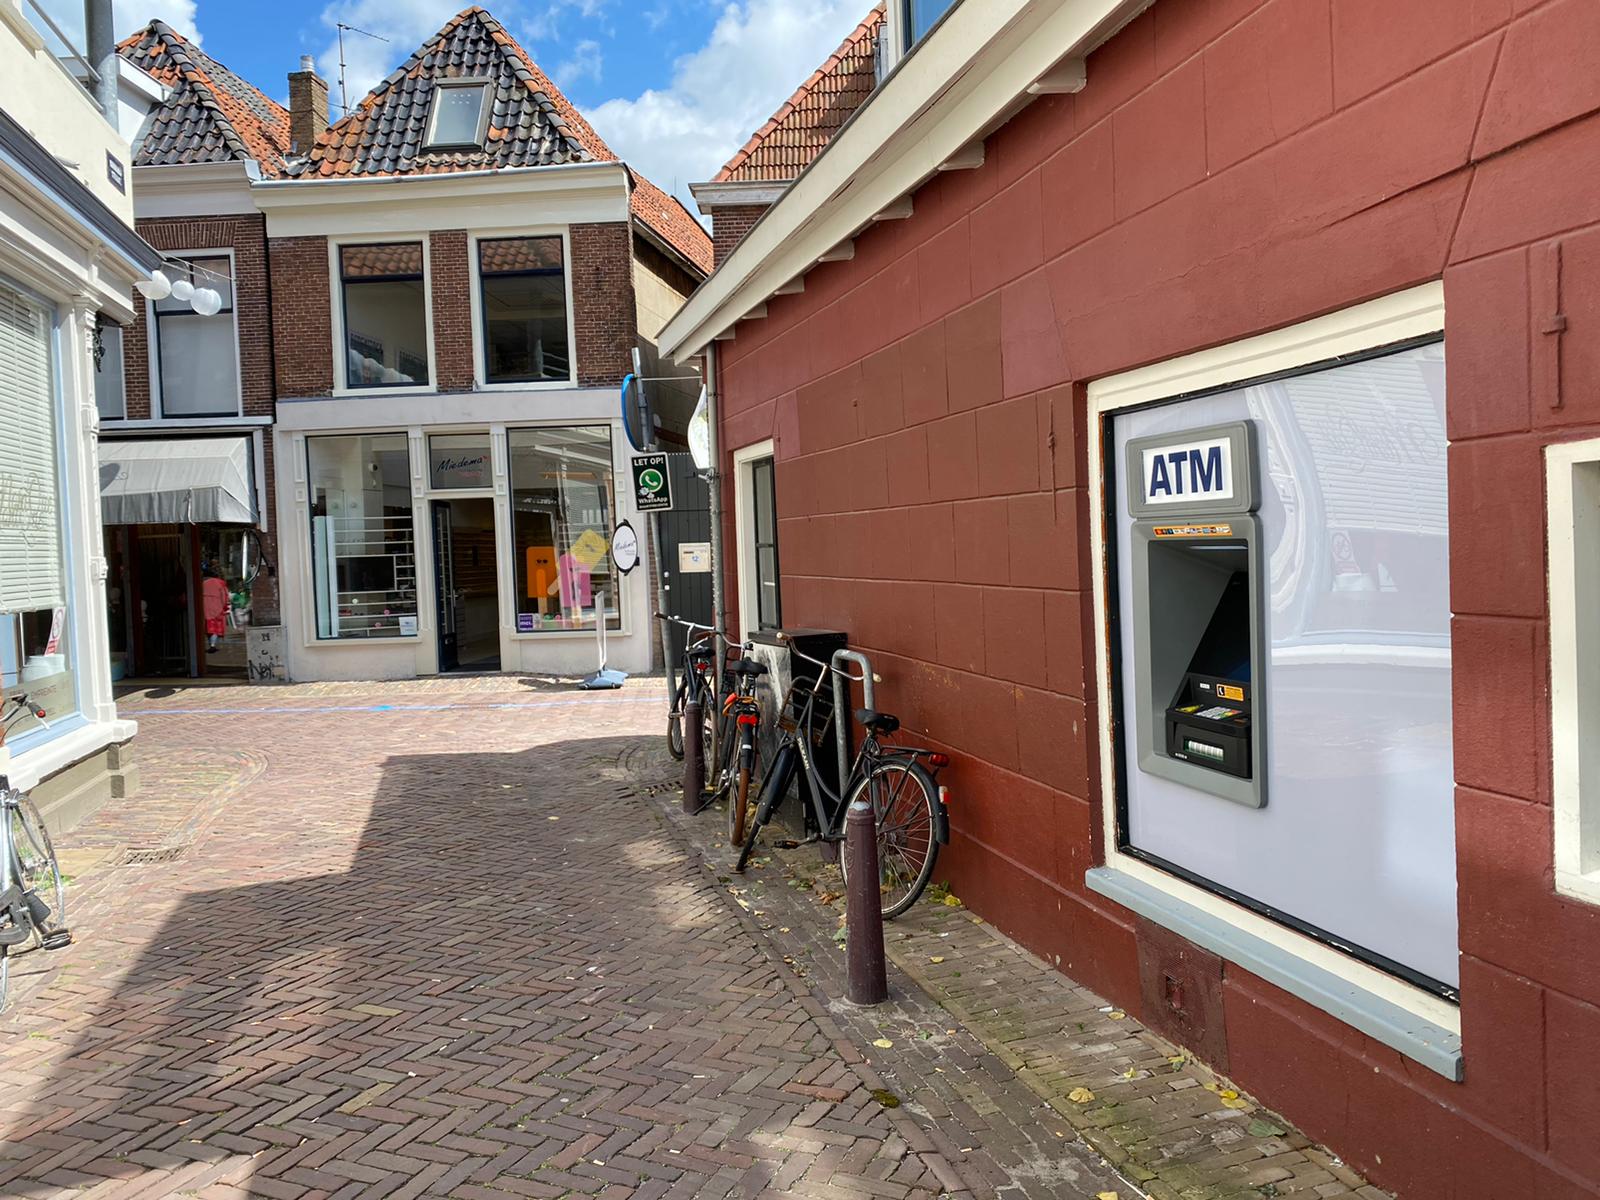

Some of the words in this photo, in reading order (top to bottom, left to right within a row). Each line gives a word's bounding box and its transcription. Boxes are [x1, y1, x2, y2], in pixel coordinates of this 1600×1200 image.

[436, 456, 483, 472] Miedema
[633, 458, 648, 466] LET
[650, 457, 664, 465] OP!
[1149, 446, 1223, 496] ATM
[638, 496, 668, 504] WhatsApp
